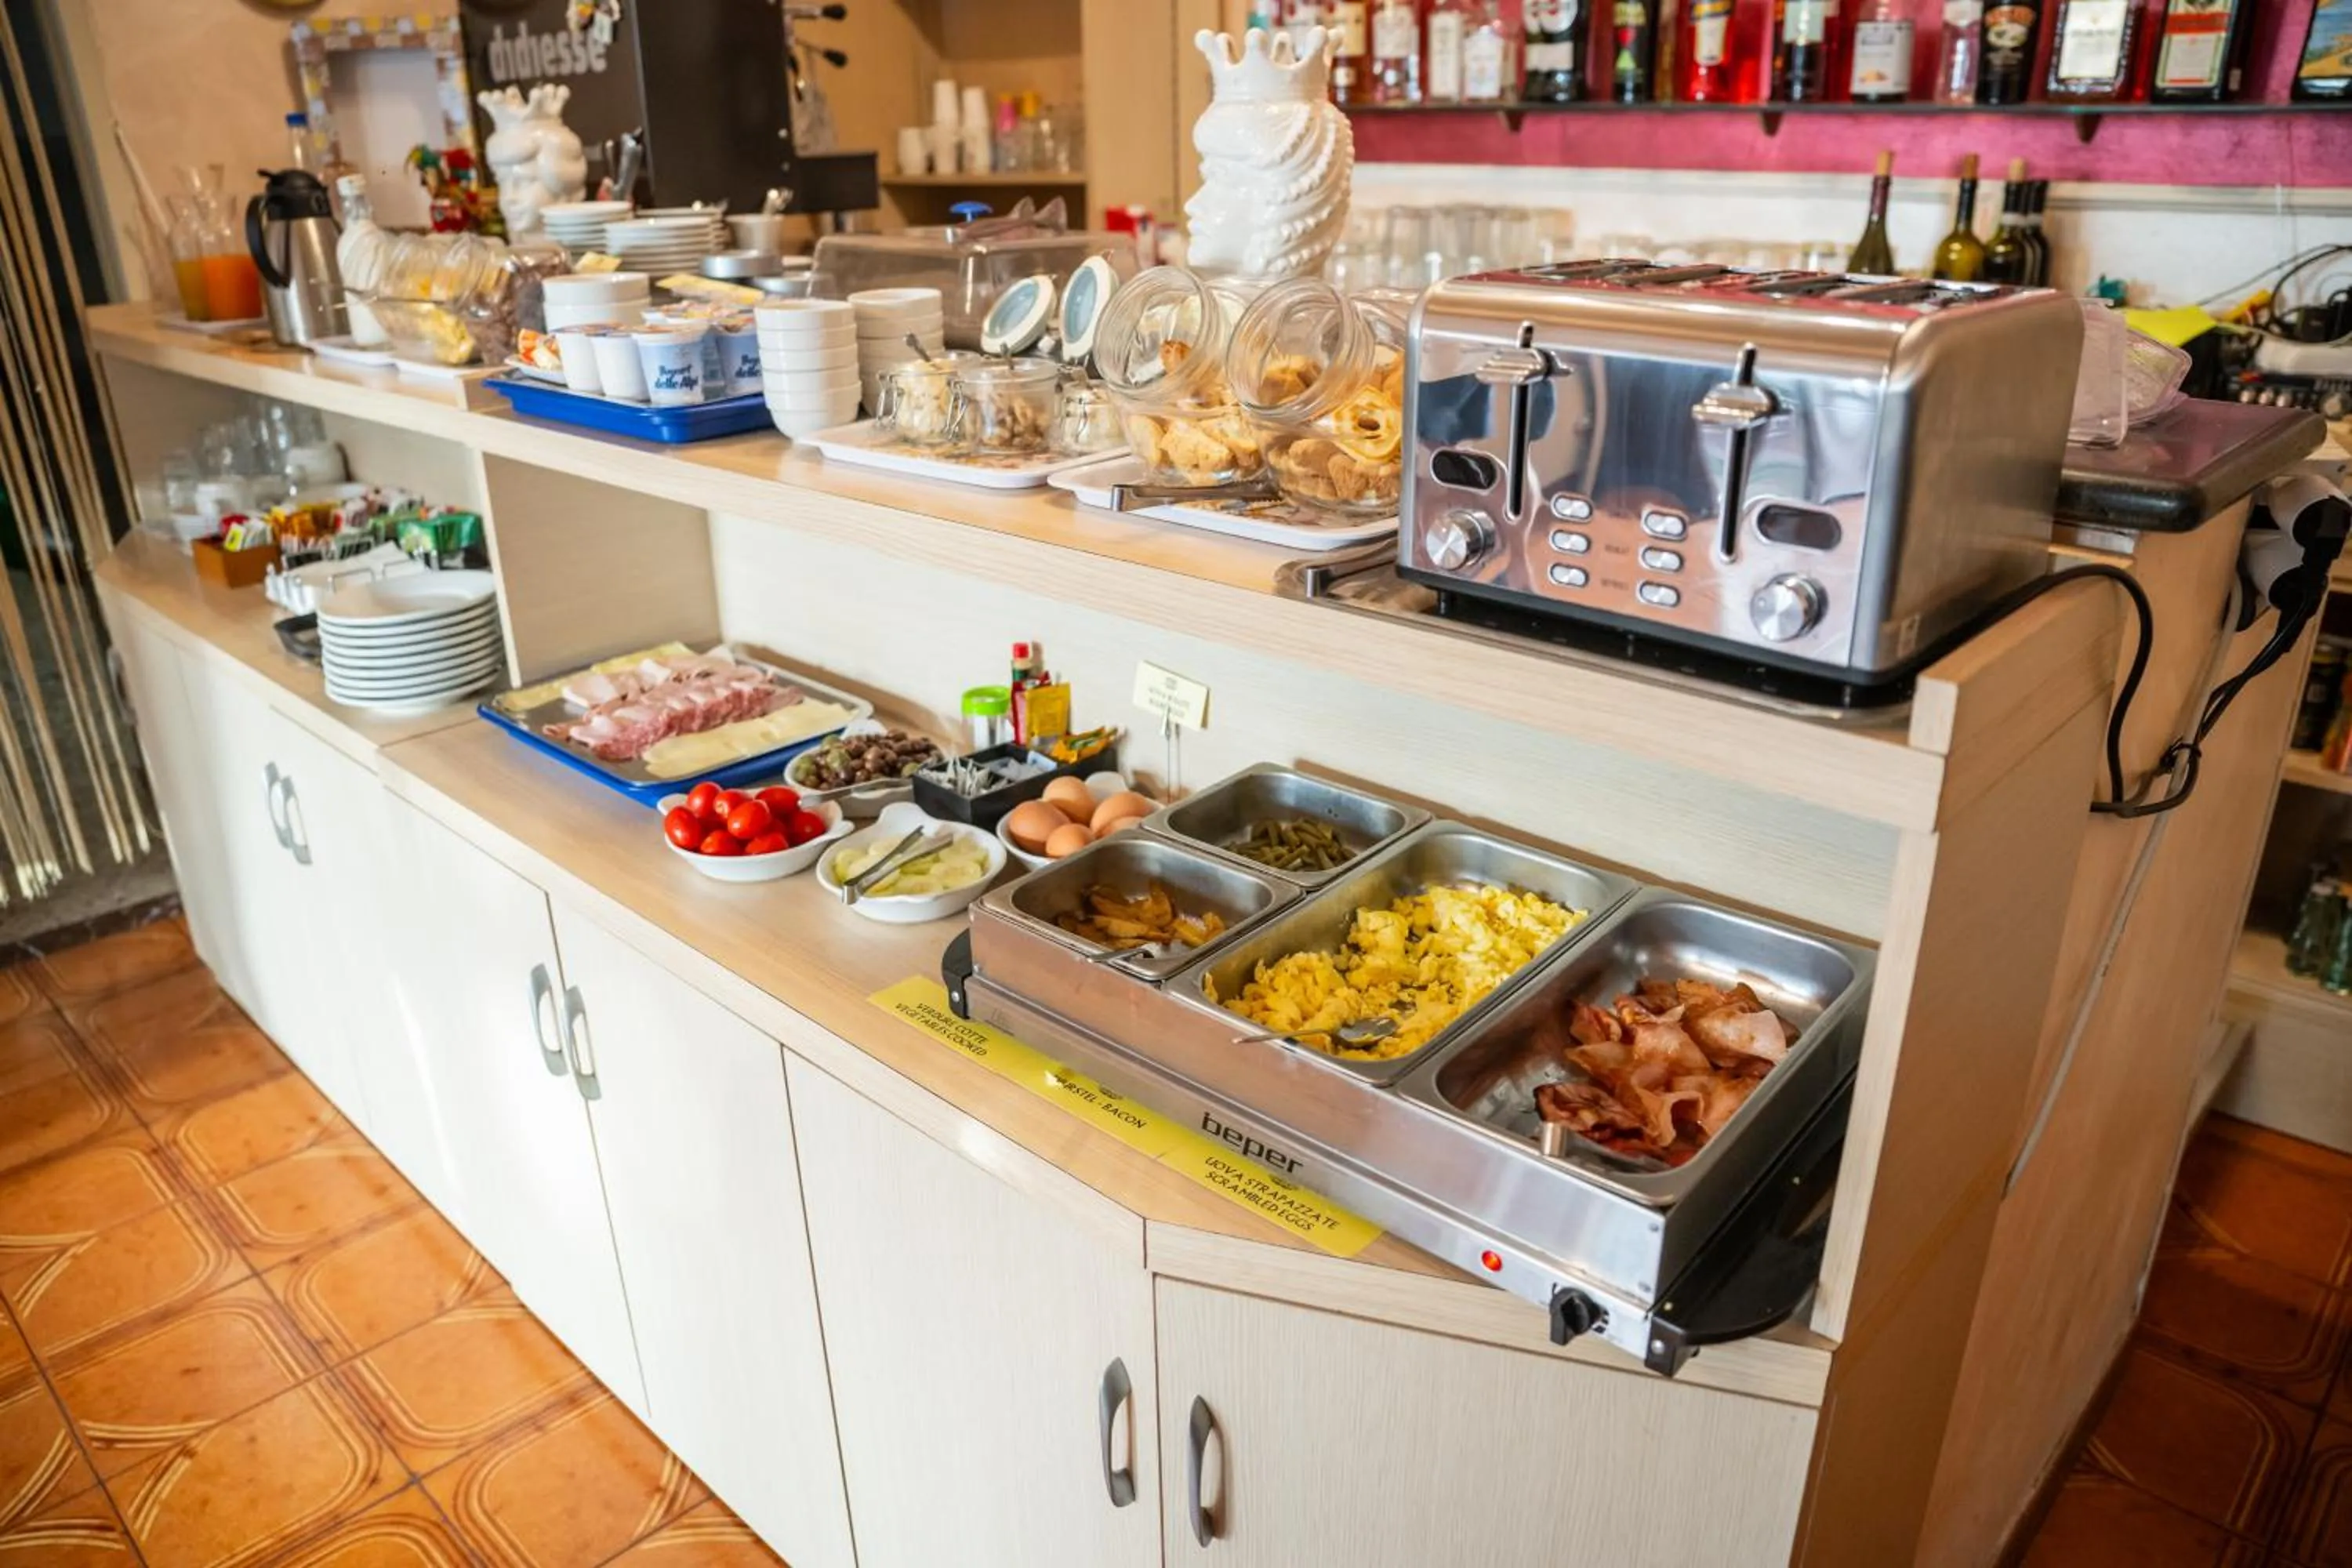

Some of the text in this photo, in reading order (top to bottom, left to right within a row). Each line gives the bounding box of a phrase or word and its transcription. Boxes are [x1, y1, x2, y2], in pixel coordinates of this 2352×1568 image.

[895, 1003, 988, 1056] VEGETABLES COOKED
[955, 1023, 988, 1044] COTTE
[1052, 1073, 1098, 1104] RSTEL
[1102, 1102, 1147, 1129] BACON
[1202, 1111, 1304, 1174] beper
[1205, 1156, 1341, 1230] UOVA STRAPAZZATE
[1205, 1171, 1316, 1232] SCRAMBLED EGGS
